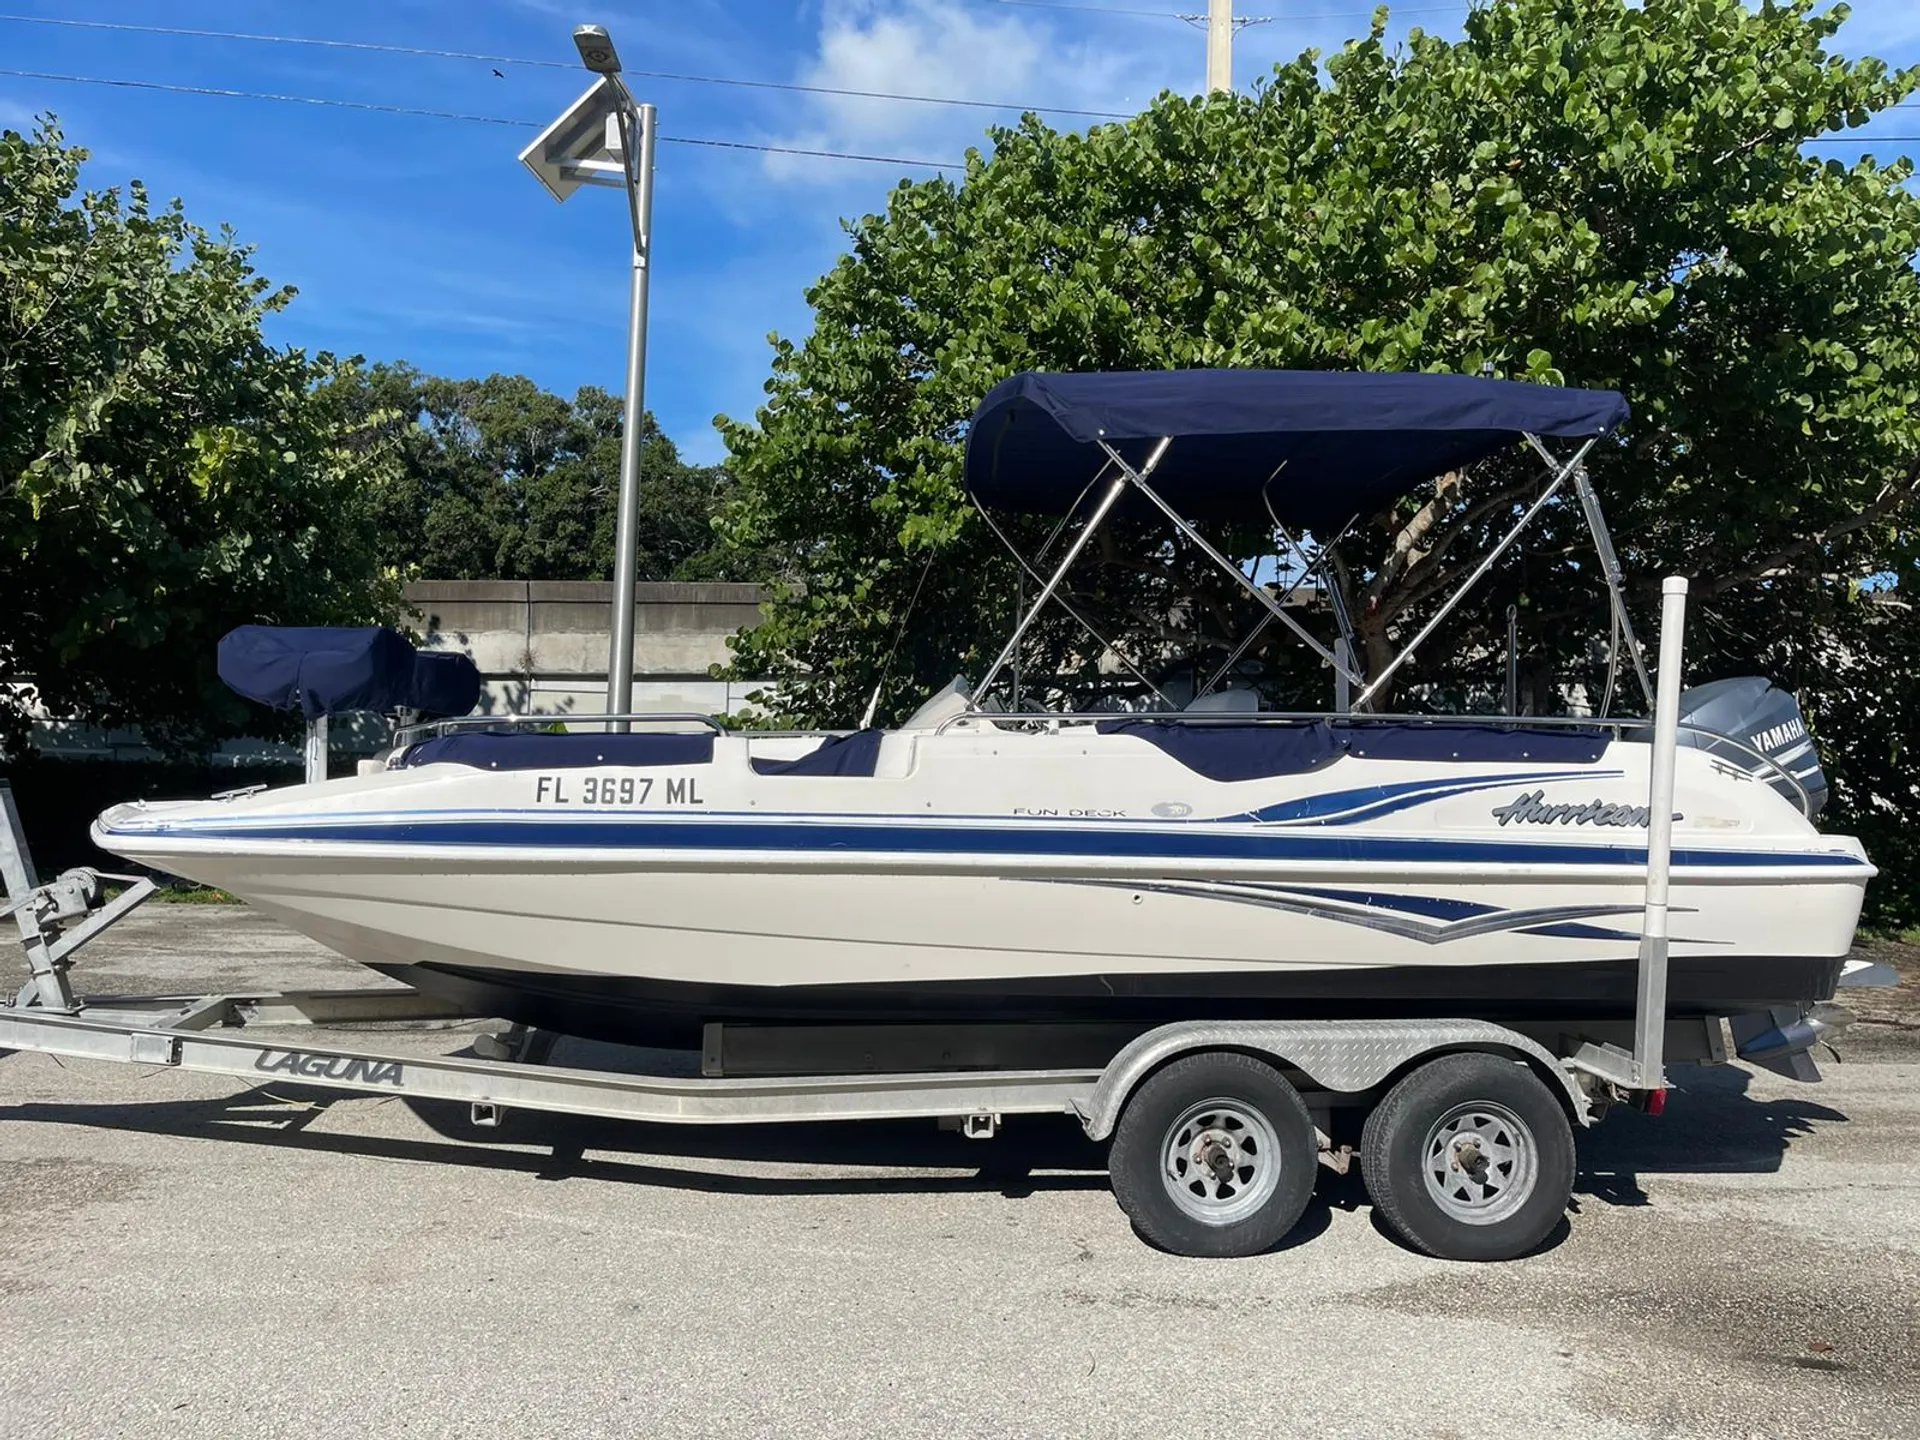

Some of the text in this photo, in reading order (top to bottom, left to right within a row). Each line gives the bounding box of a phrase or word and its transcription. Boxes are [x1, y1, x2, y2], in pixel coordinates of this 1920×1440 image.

[1750, 717, 1806, 752] YAMAHA
[536, 776, 704, 805] FL 3697 ML
[1013, 807, 1127, 818] FUN DECK
[1492, 789, 1684, 828] Hurrican
[254, 1049, 405, 1087] LAGUNA
